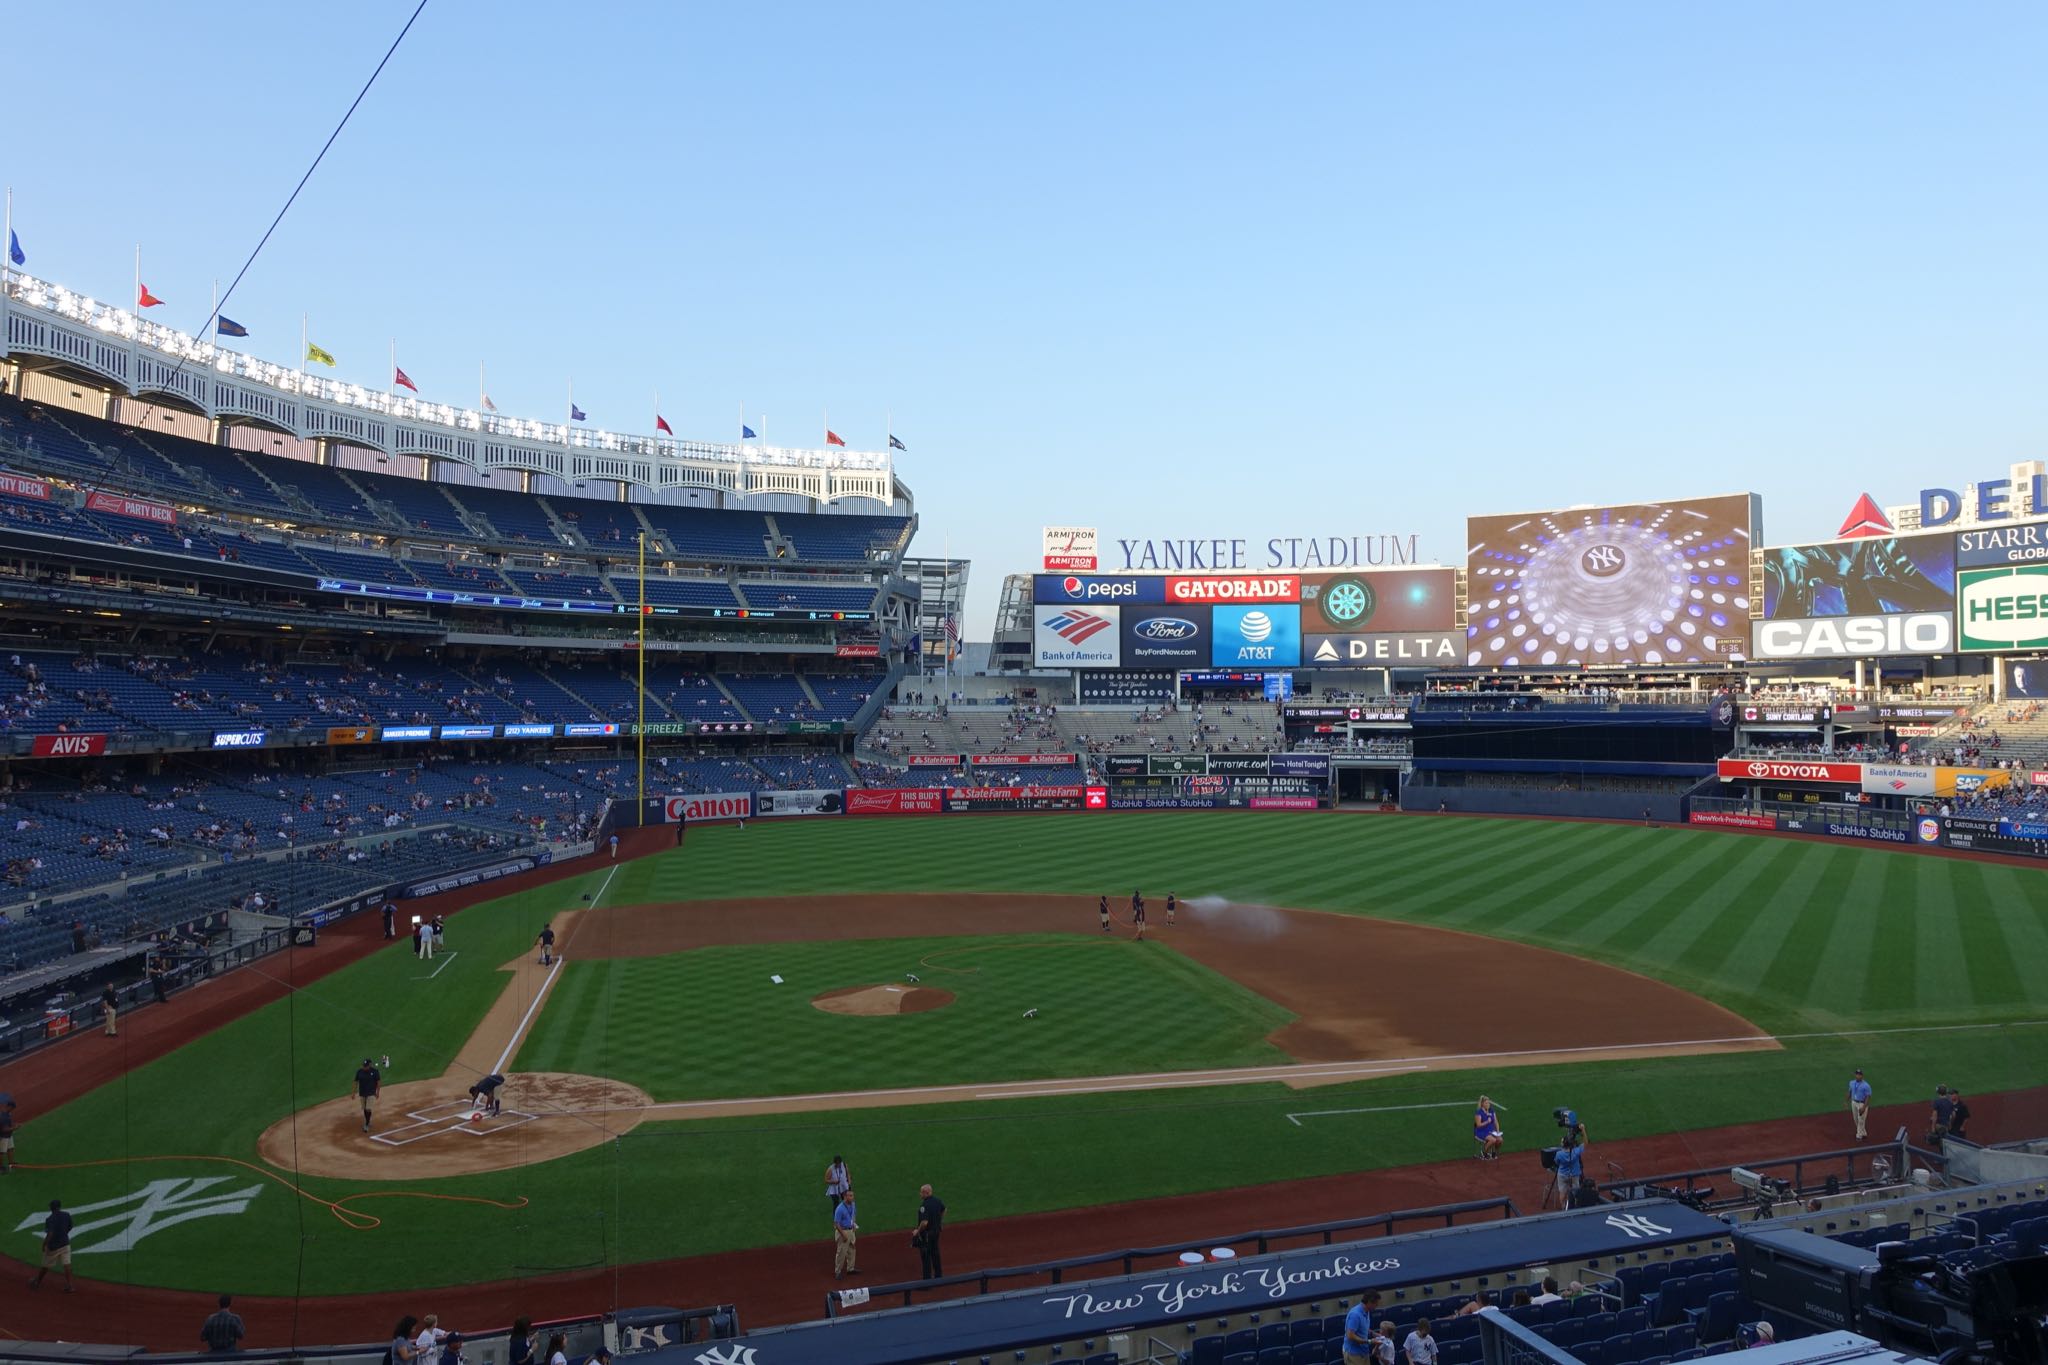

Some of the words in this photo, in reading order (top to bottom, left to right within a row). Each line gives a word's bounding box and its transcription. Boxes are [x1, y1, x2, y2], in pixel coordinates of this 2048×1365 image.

[18, 480, 44, 497] DECK
[125, 501, 150, 517] PARTY
[152, 505, 172, 521] DECK
[1047, 531, 1095, 539] ARMITRON
[1960, 526, 2039, 551] STARR
[1117, 538, 1246, 570] YANKEE
[1267, 534, 1420, 568] STADIUM
[1588, 546, 1622, 570] NY
[1049, 557, 1093, 565] ARMITRON
[1088, 580, 1137, 599] pepsi
[1174, 579, 1292, 598] GATORADE
[1146, 621, 1185, 638] Ford
[1761, 615, 1949, 655] CASIO
[836, 646, 879, 657] Budweiser
[1042, 651, 1064, 660] Bank
[1066, 651, 1075, 660] of
[1076, 651, 1112, 660] America
[1237, 646, 1275, 660] AT&T
[1350, 638, 1456, 659] DELTA
[1880, 709, 1891, 717] 212
[1896, 709, 1923, 717] YANKEES
[214, 733, 264, 746] SUPERCUTS
[356, 731, 366, 739] SAP
[51, 737, 90, 754] AVIS
[1771, 765, 1829, 778] TOYOTA
[1870, 768, 1887, 776] Bank
[1897, 770, 1927, 778] America
[1956, 777, 1982, 791] SAP
[901, 792, 916, 800] THIS
[918, 791, 941, 800] BUD'S
[1845, 792, 1872, 803] FedEx
[667, 798, 750, 820] Canon
[901, 801, 915, 809] FOR
[917, 801, 933, 809] YOU.
[1111, 800, 1143, 808] StubHub
[1145, 799, 1178, 808] StubHub
[1180, 799, 1213, 808] StubHub
[1830, 824, 1867, 837] StubHub
[1869, 828, 1905, 841] StubHub
[1945, 819, 1952, 828] G
[1954, 821, 1987, 830] GATORADE
[1989, 823, 1996, 832] G
[2023, 826, 2047, 836] pepsi
[1605, 1214, 1672, 1238] NY
[1044, 1293, 1144, 1318] New
[1141, 1272, 1246, 1314] York
[1243, 1256, 1401, 1298] Yankees
